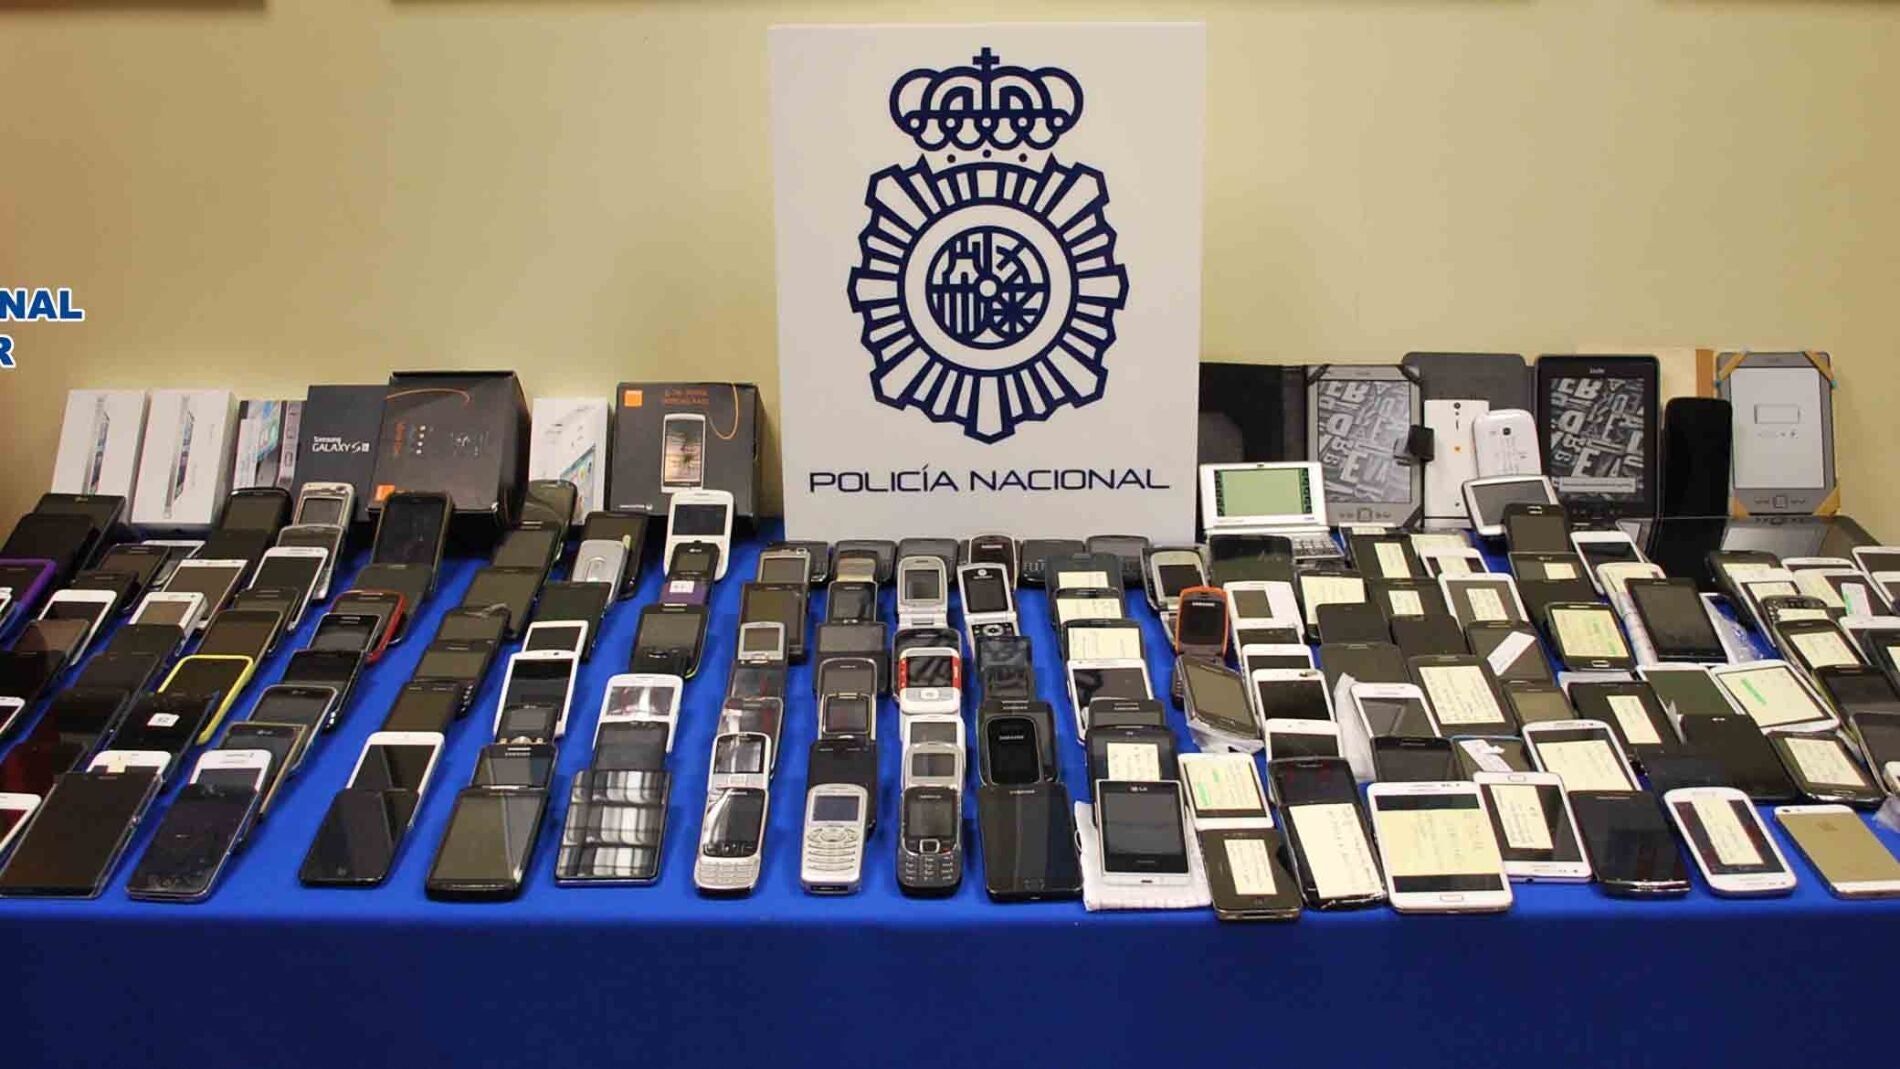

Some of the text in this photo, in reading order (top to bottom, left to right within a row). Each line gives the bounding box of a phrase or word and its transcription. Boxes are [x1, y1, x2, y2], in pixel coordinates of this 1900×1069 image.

[312, 443, 350, 452] GALAXY
[809, 464, 1170, 493] POLICÍA NACIONAL
